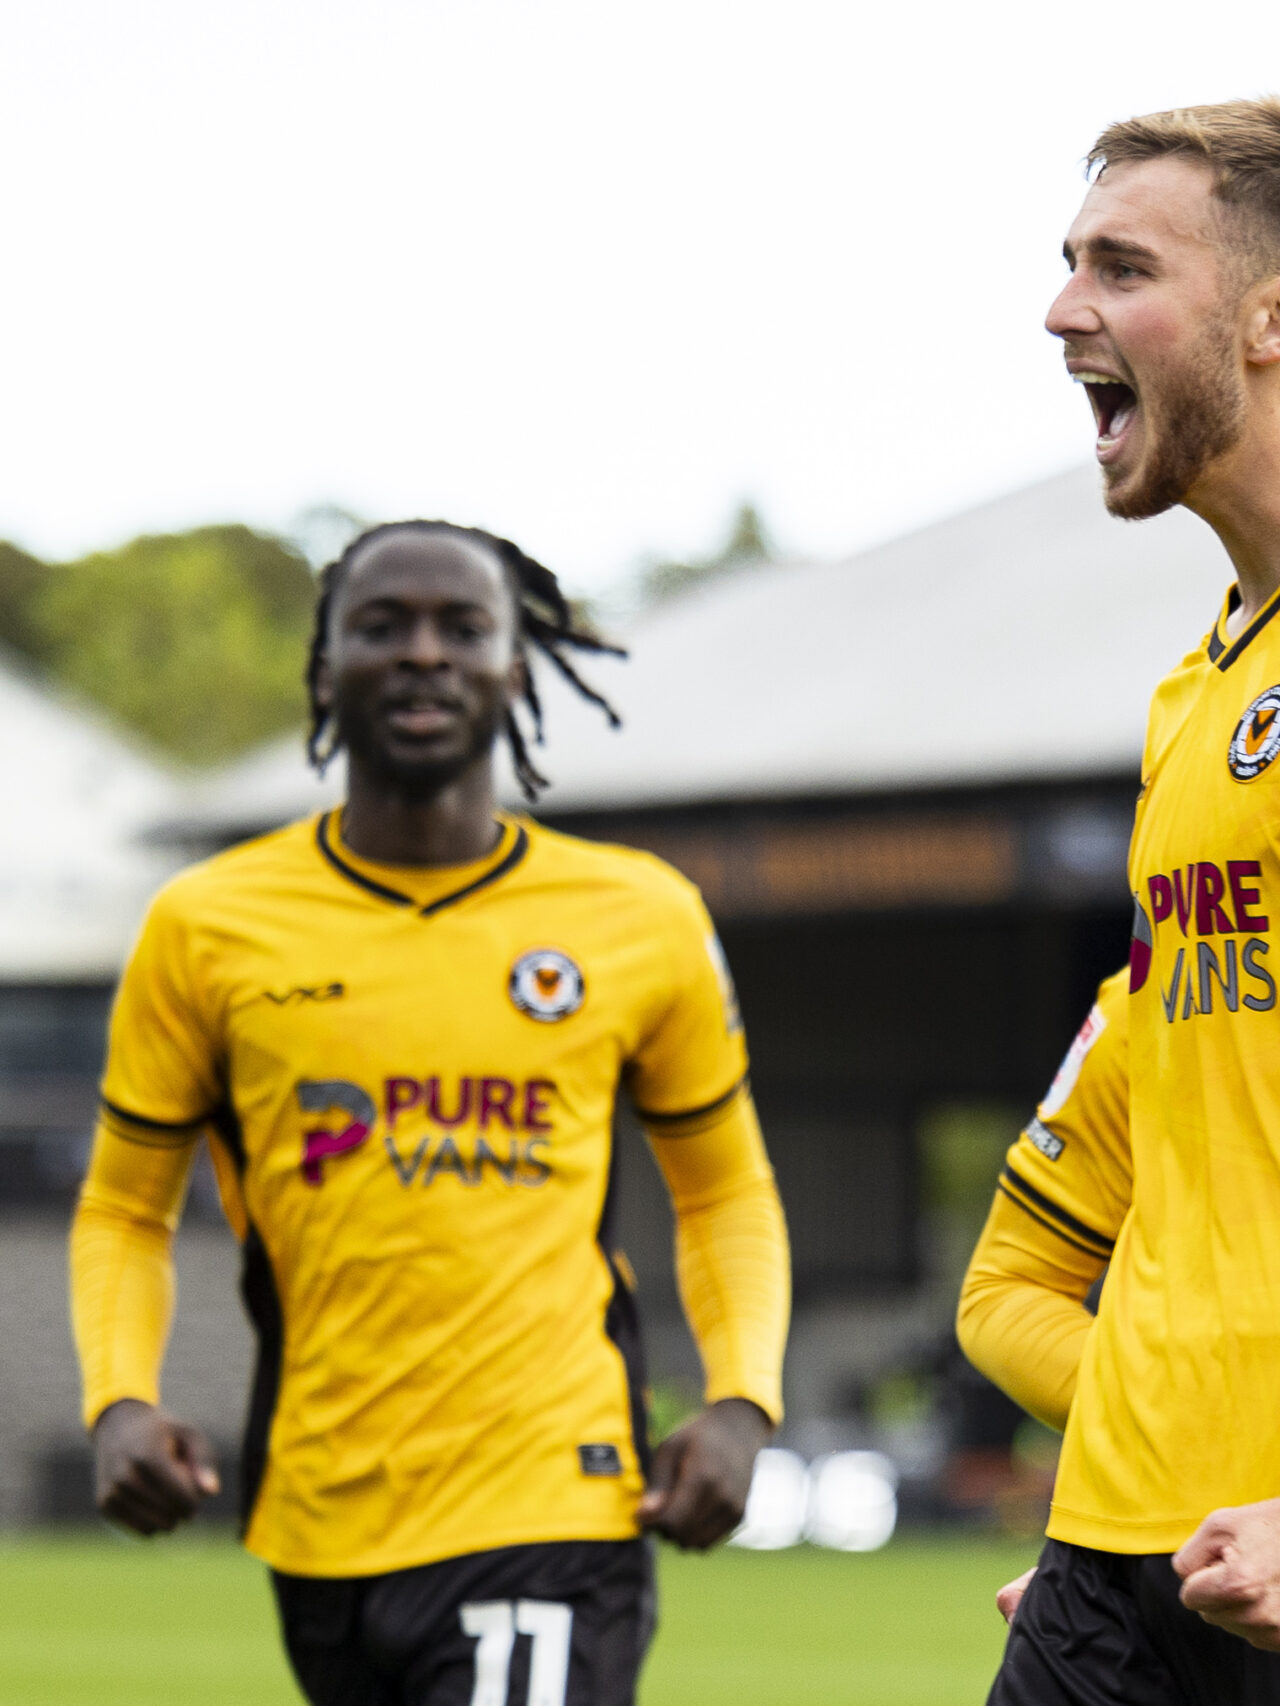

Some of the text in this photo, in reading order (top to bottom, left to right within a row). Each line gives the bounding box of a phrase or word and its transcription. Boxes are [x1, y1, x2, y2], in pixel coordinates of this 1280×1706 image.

[384, 1075, 556, 1131] PURE
[385, 1134, 554, 1188] VANS
[459, 1598, 573, 1706] 11
